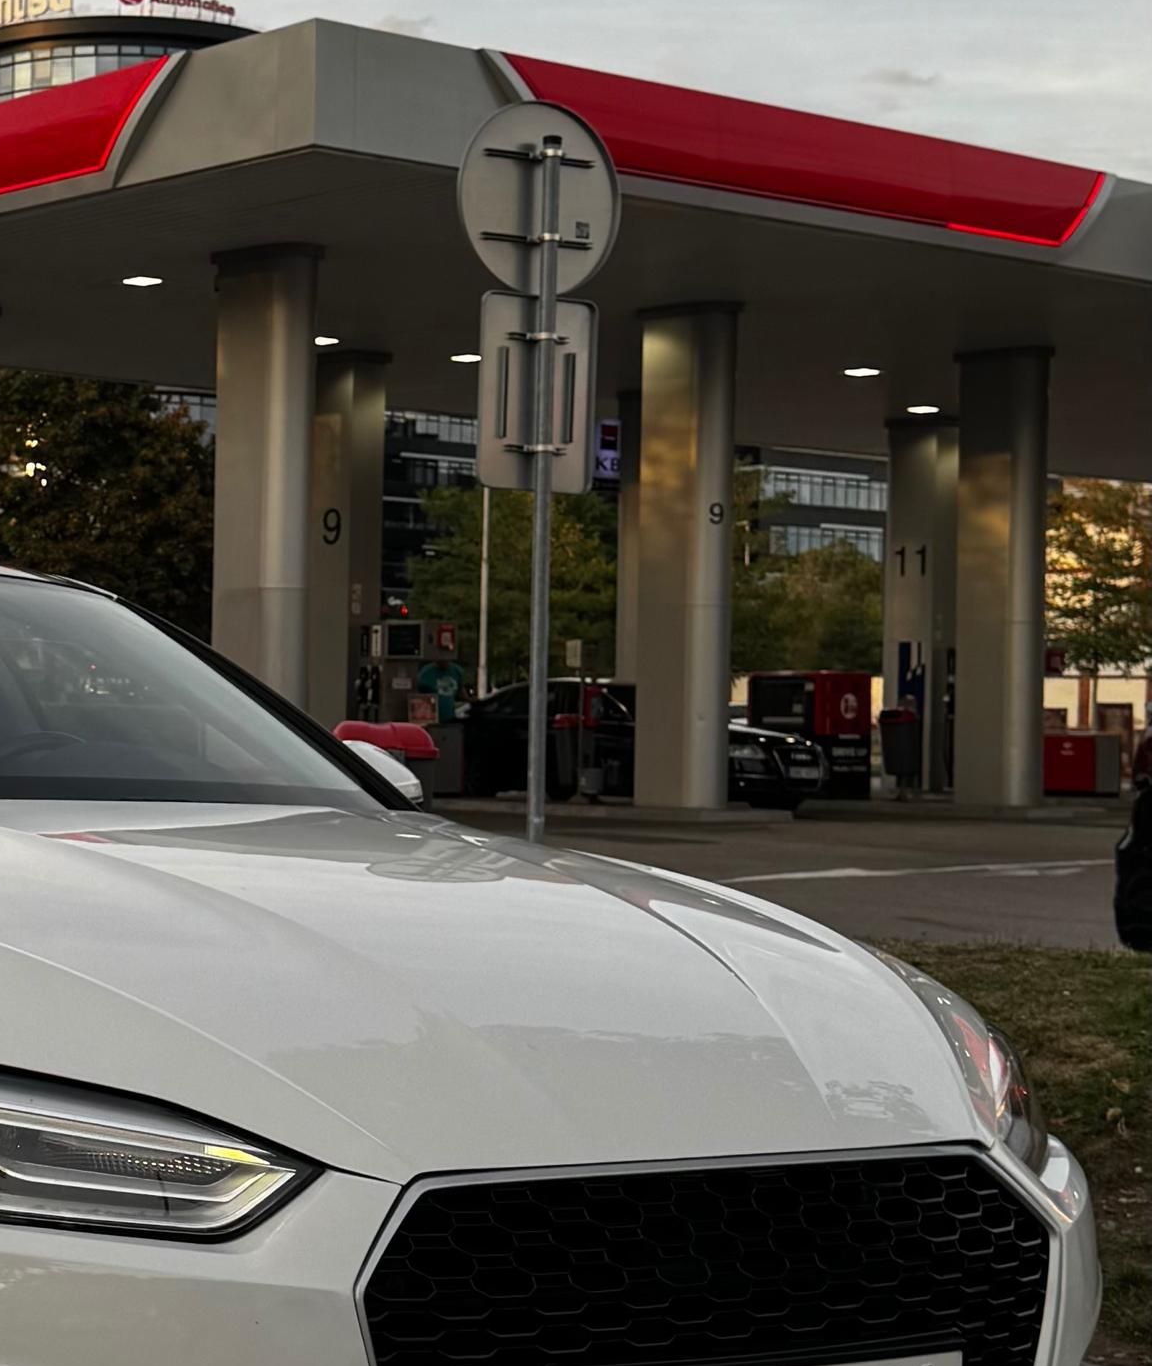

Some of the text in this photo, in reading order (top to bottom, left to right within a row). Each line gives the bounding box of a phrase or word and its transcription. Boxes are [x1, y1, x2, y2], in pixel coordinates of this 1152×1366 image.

[595, 457, 619, 472] KB
[323, 508, 342, 545] 9
[709, 502, 724, 525] 9
[895, 545, 926, 577] 11
